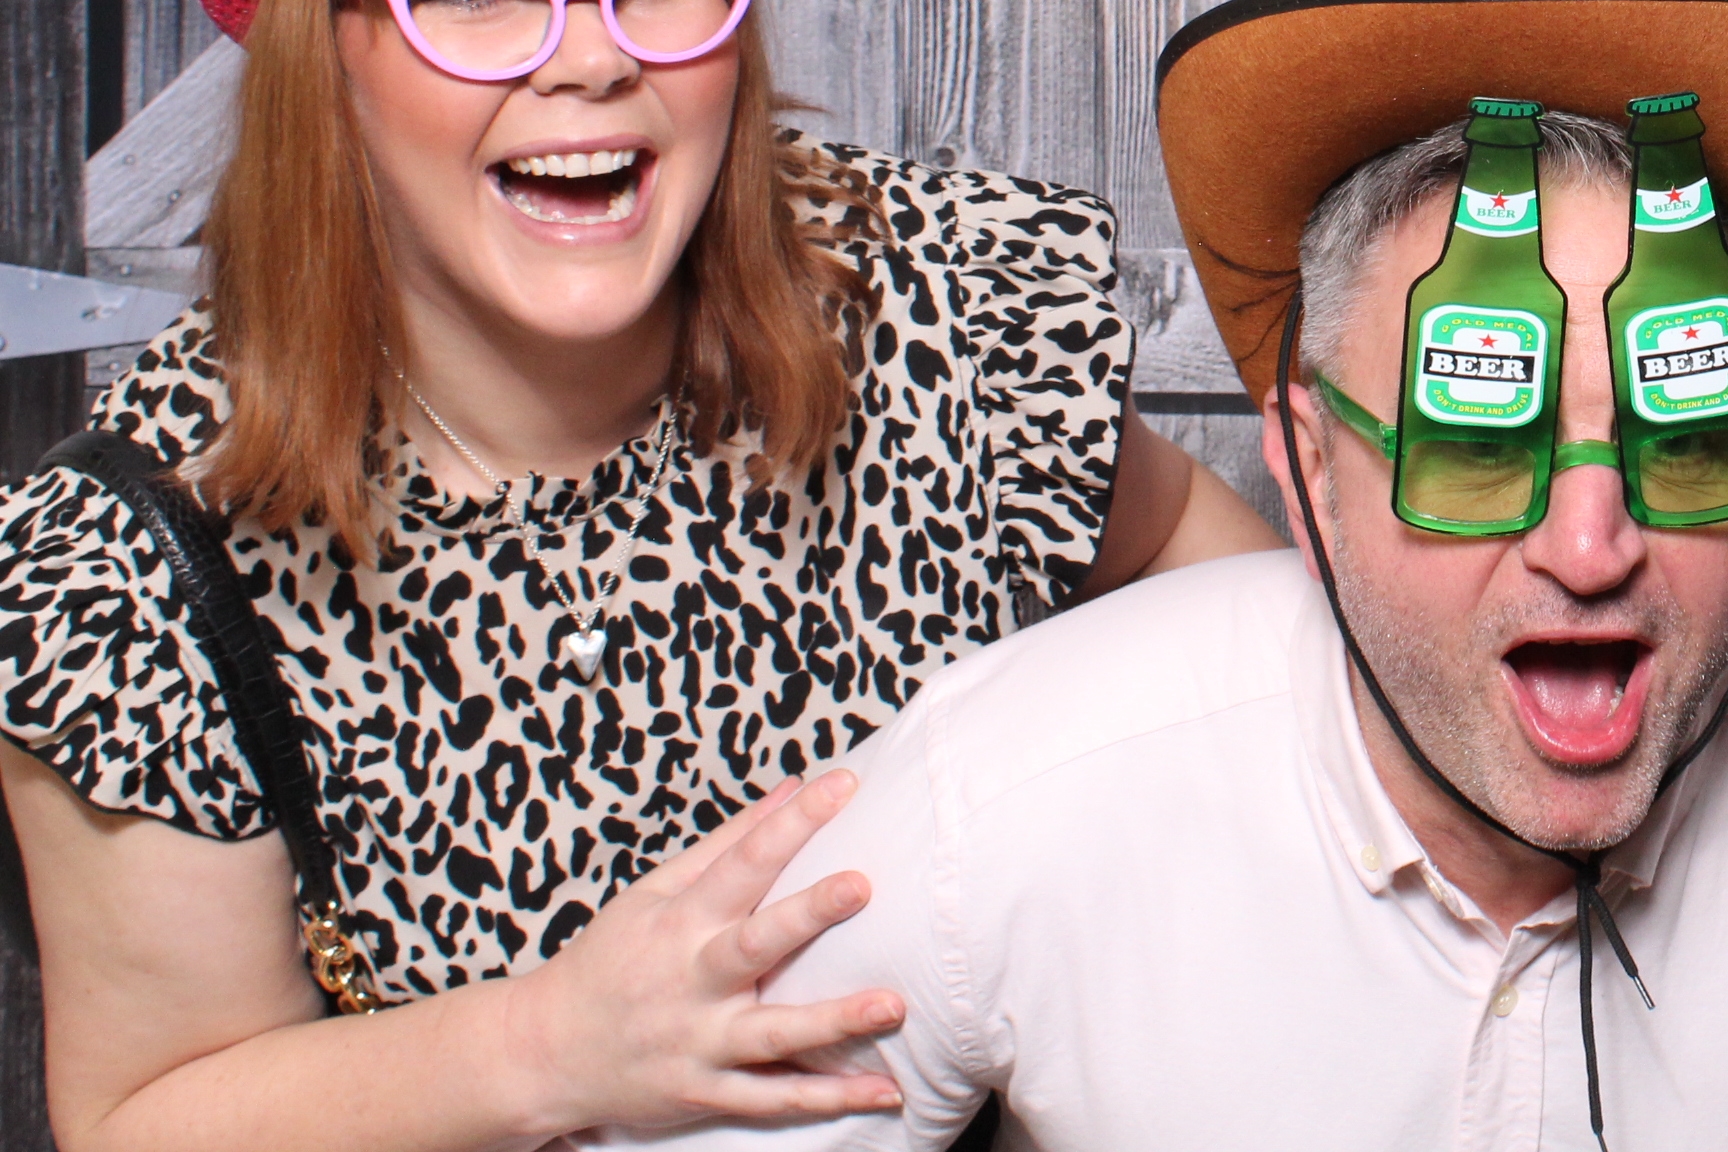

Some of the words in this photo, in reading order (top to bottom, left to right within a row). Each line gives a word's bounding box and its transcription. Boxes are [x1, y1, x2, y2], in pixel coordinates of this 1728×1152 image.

[1476, 207, 1516, 219] BEER
[1654, 200, 1692, 214] BEER
[1441, 318, 1485, 333] GOLD
[1493, 321, 1533, 350] MEDAL
[1645, 317, 1684, 339] GOLD
[1428, 352, 1526, 380] BEER
[1433, 389, 1457, 410] DON'T
[1458, 405, 1484, 414] DRINK
[1486, 407, 1504, 415] AND
[1506, 393, 1528, 414] DRIVE
[1650, 393, 1675, 410] DON'T
[1676, 401, 1703, 410] DRINK
[1704, 398, 1721, 406] AND
